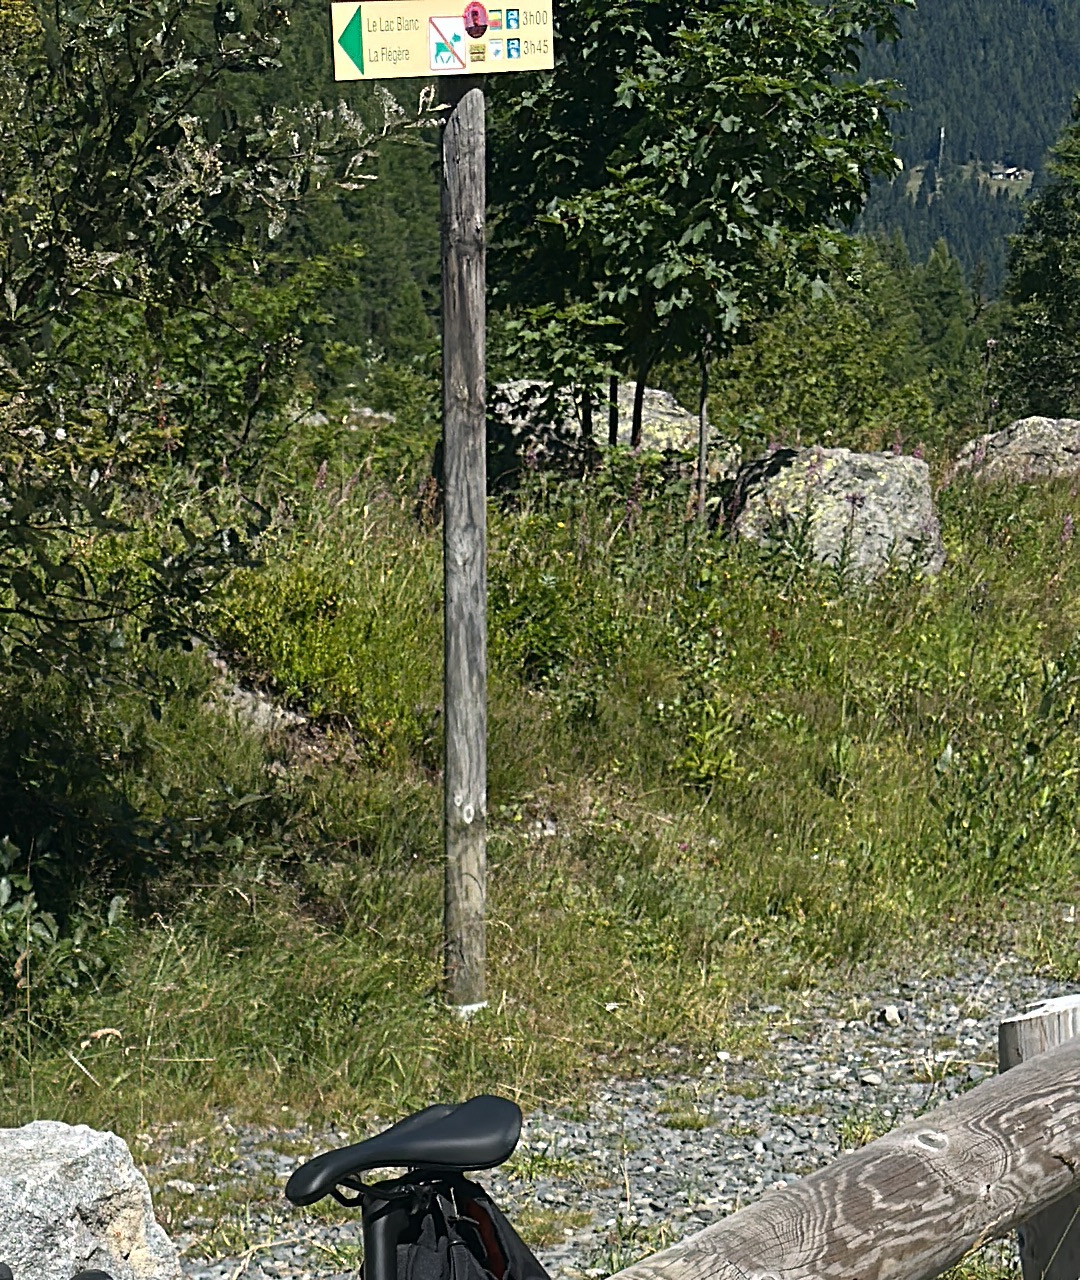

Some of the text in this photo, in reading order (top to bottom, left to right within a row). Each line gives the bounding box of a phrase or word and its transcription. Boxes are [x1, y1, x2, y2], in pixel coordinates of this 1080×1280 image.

[367, 16, 419, 32] Le Lac Blanc
[522, 10, 548, 26] 3h00
[523, 39, 549, 55] 3h45
[368, 49, 378, 62] La
